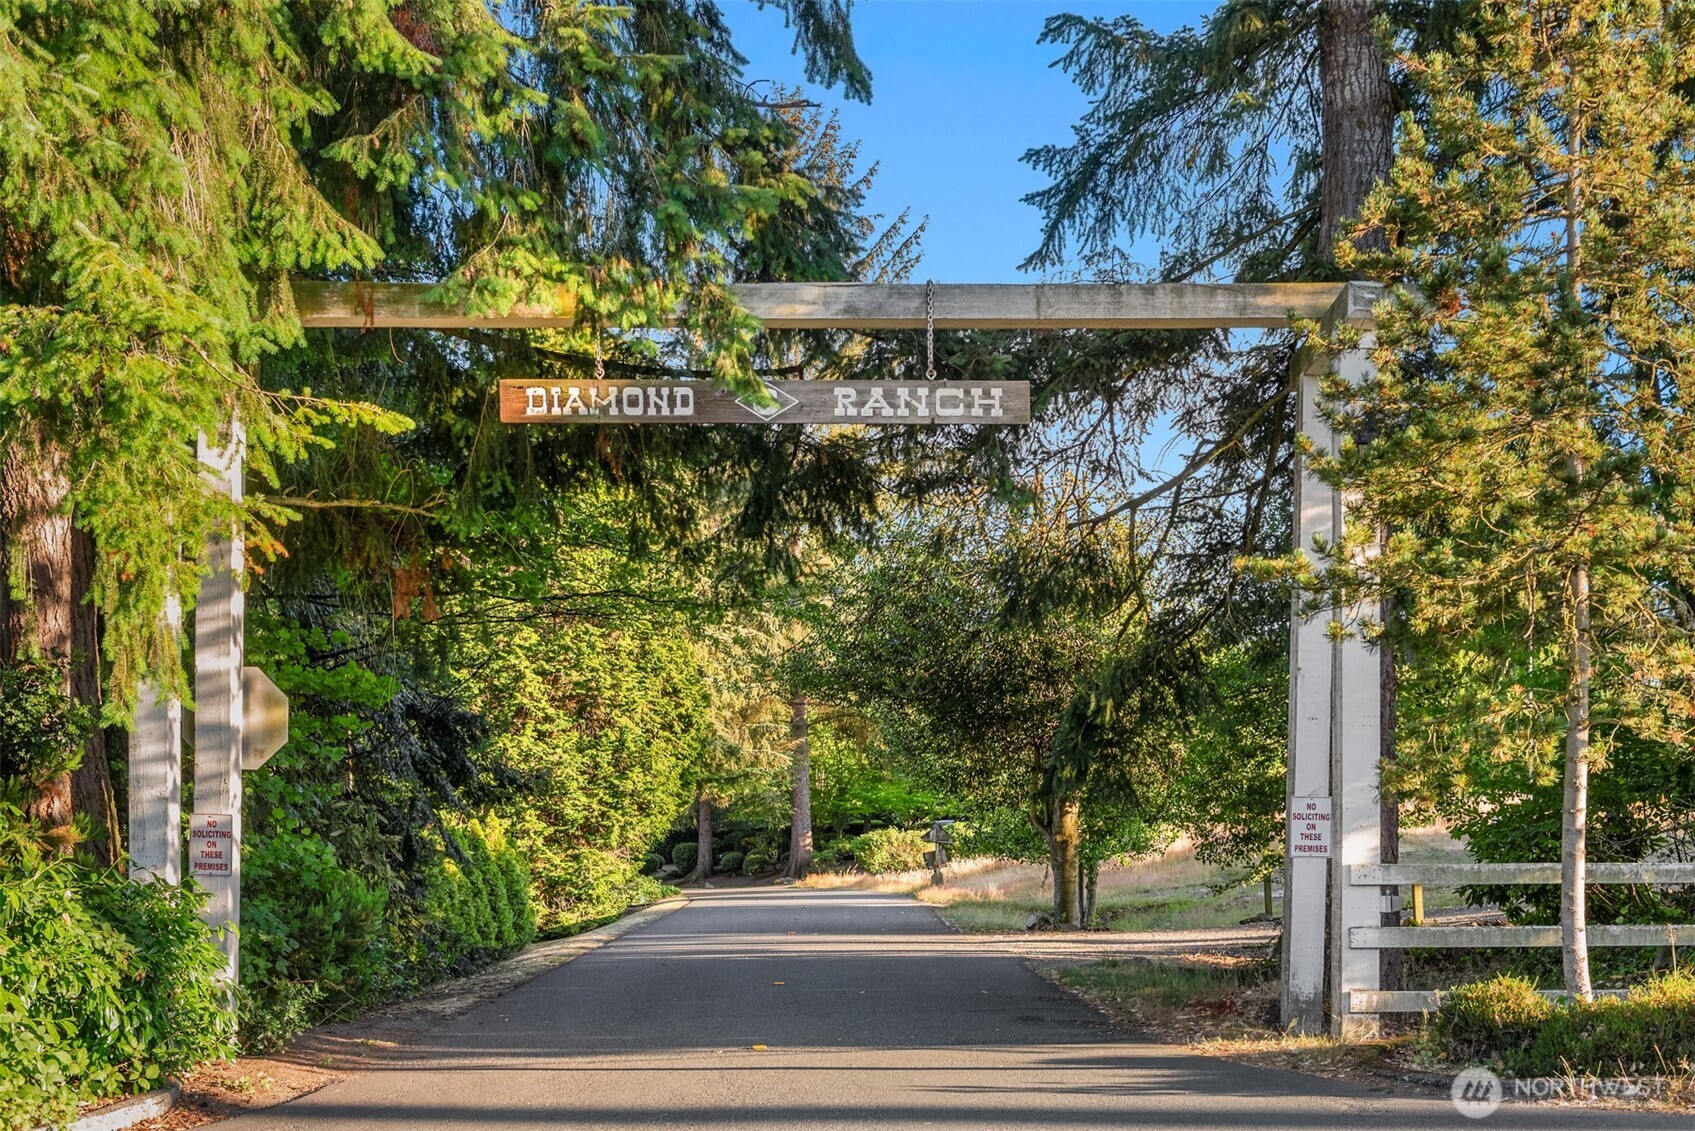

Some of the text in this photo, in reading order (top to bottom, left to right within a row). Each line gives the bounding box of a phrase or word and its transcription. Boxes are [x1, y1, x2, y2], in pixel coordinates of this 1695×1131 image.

[525, 386, 1004, 417] DIAMOND RANCH
[1292, 812, 1331, 821] SOLICITING
[206, 820, 217, 828] NO
[192, 830, 232, 839] SOLICITING
[1300, 833, 1322, 841] THESE
[1294, 845, 1328, 853] PREMISES
[200, 850, 223, 859] THESE
[193, 862, 229, 871] PREMISES
